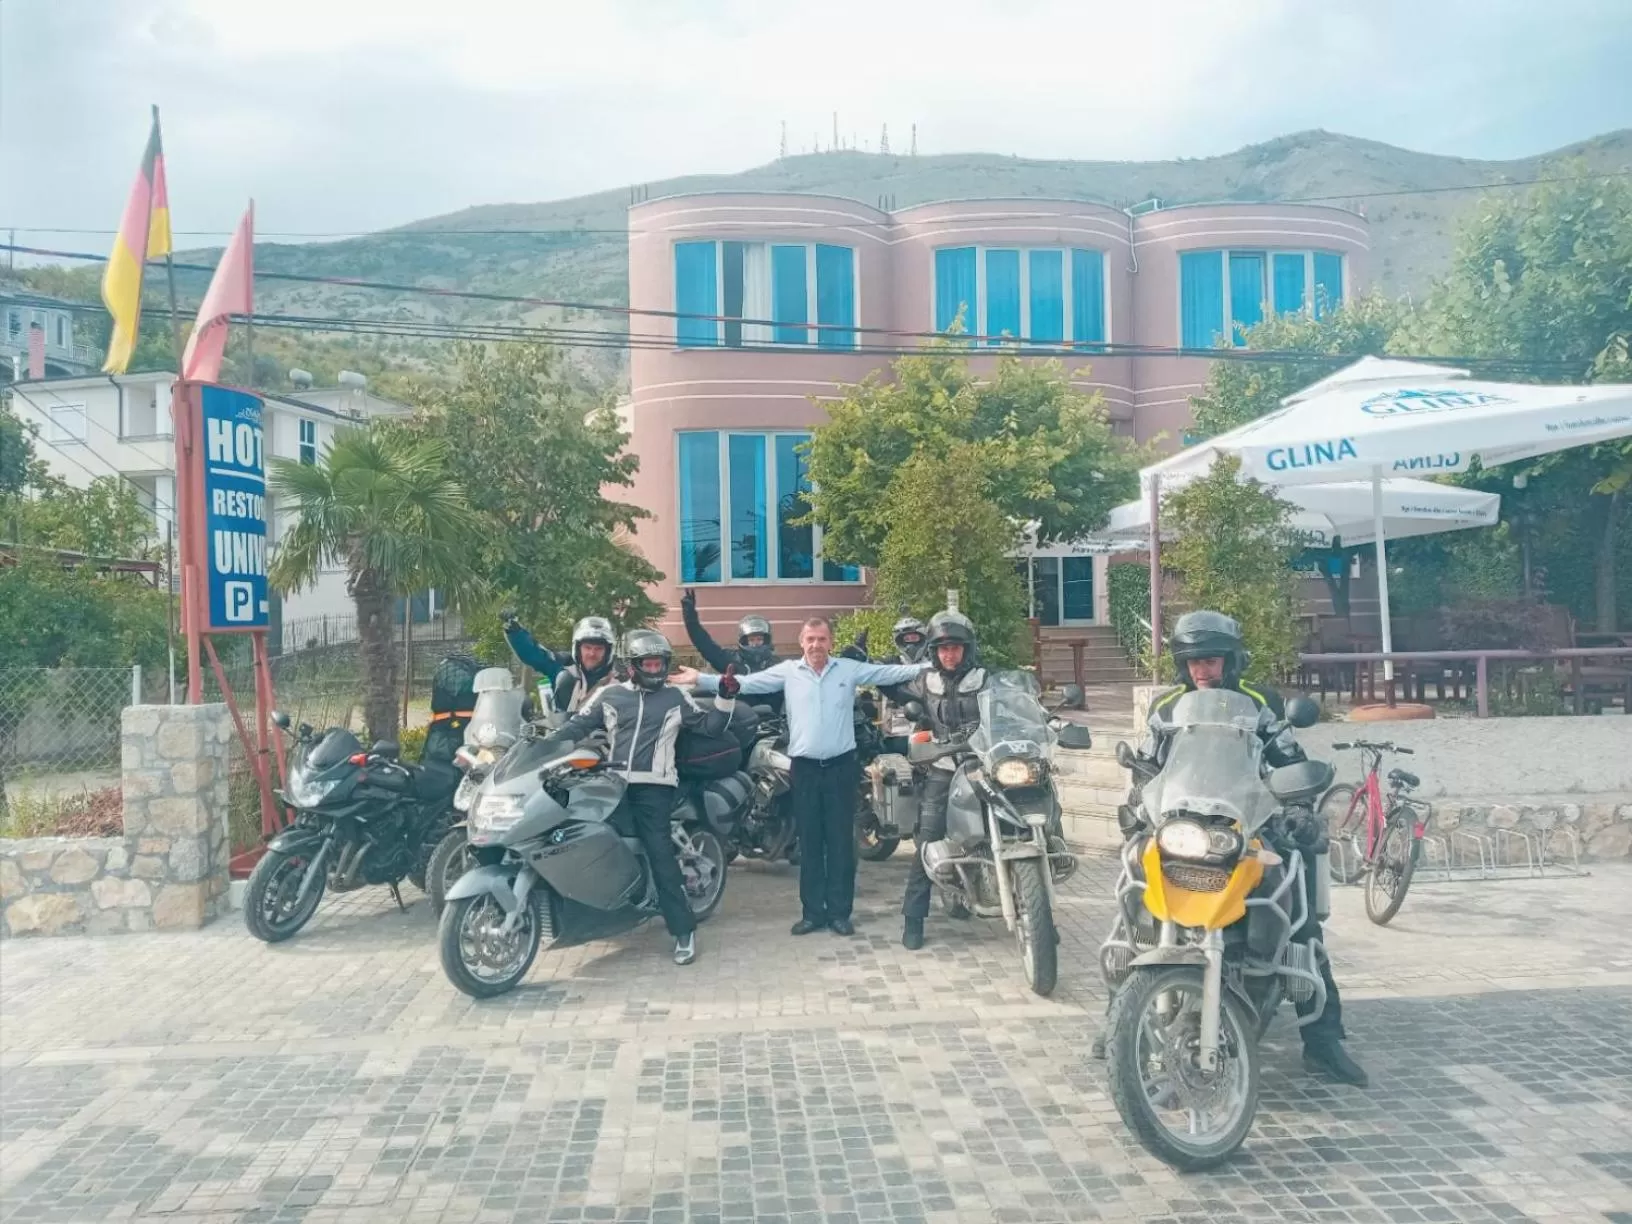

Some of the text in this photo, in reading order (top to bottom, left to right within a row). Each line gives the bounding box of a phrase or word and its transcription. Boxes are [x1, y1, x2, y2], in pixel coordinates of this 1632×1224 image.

[1361, 394, 1518, 414] GLINA
[1266, 437, 1358, 471] GLINA
[233, 587, 249, 617] P
